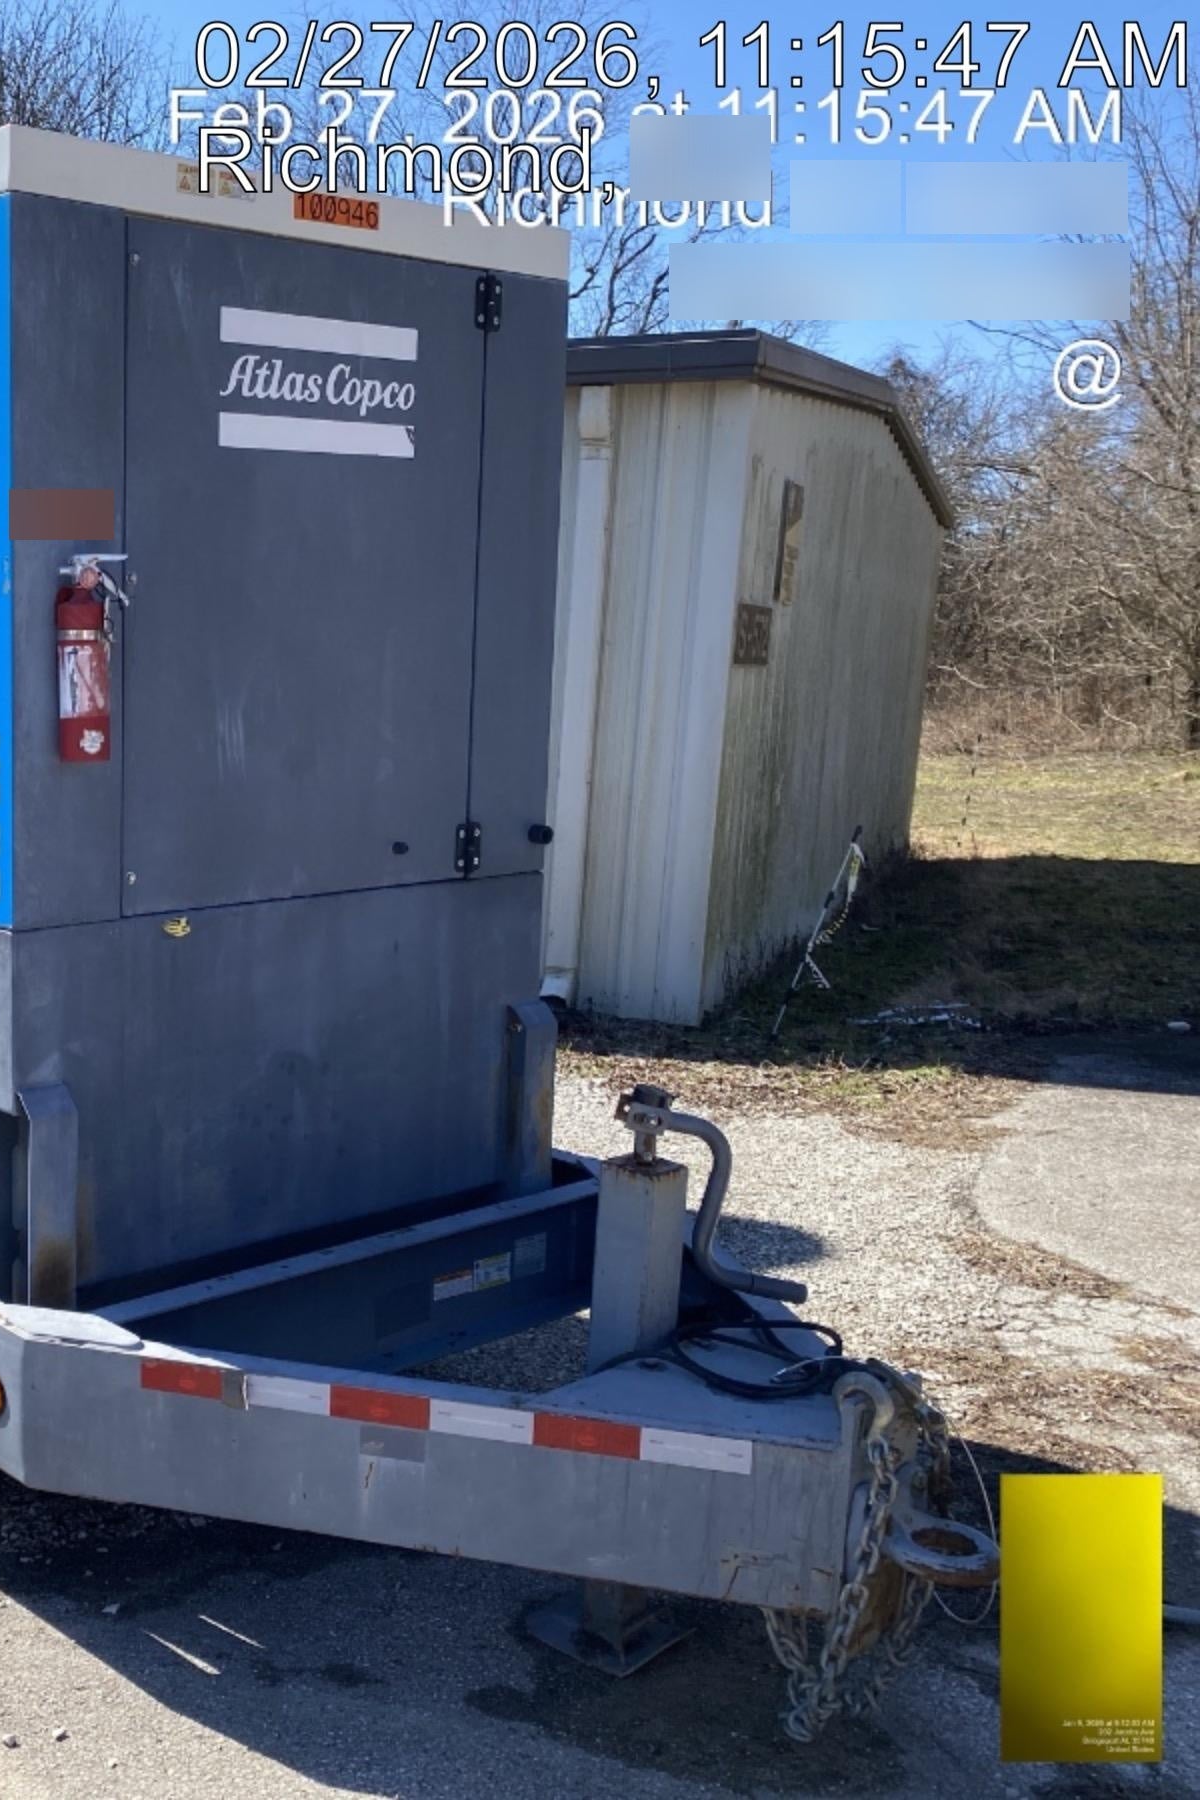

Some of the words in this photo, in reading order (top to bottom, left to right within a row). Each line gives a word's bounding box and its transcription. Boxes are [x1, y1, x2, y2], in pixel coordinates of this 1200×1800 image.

[296, 192, 379, 229] 100946
[219, 354, 323, 403] Atlas
[325, 363, 416, 417] Copco
